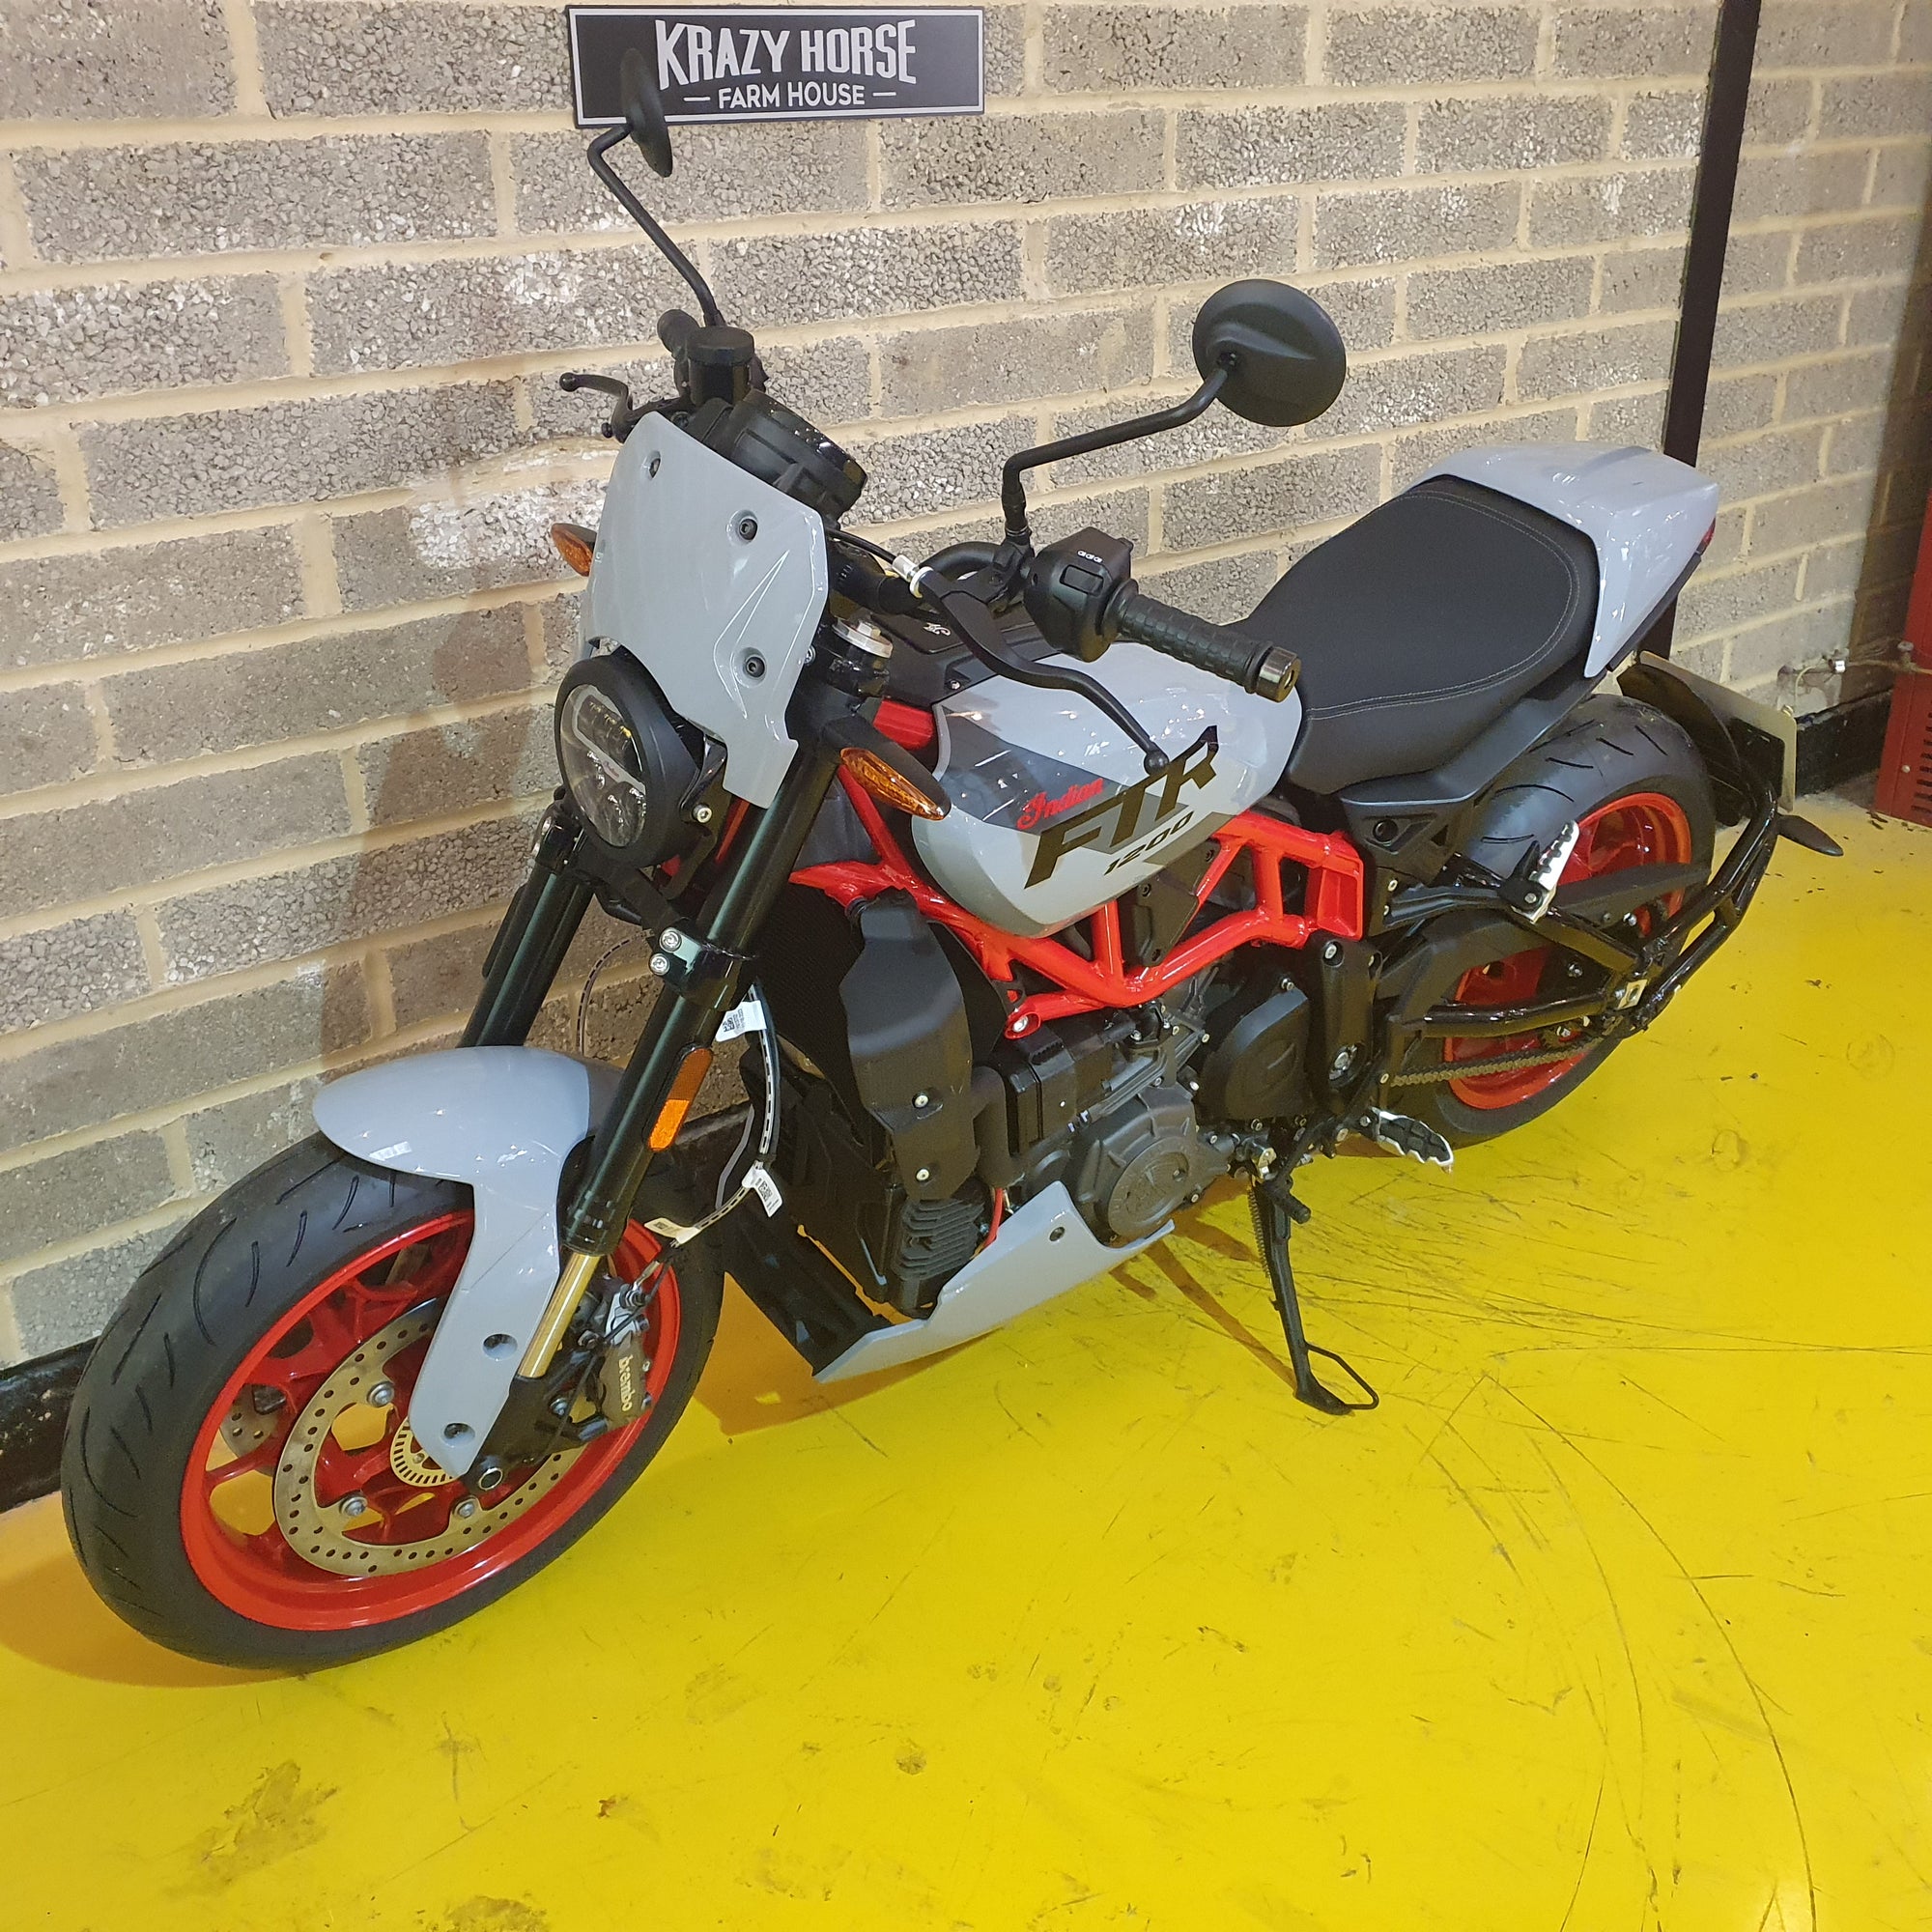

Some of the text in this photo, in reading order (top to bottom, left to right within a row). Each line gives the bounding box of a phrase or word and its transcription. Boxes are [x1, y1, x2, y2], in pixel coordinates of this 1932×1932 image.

[655, 19, 917, 90] KRAZY HORSE
[718, 82, 866, 109] FARM HOUSE
[1016, 777, 1104, 830] Indian
[1024, 724, 1219, 889] FTR
[1104, 810, 1195, 875] 1200
[618, 1354, 636, 1411] brembo
